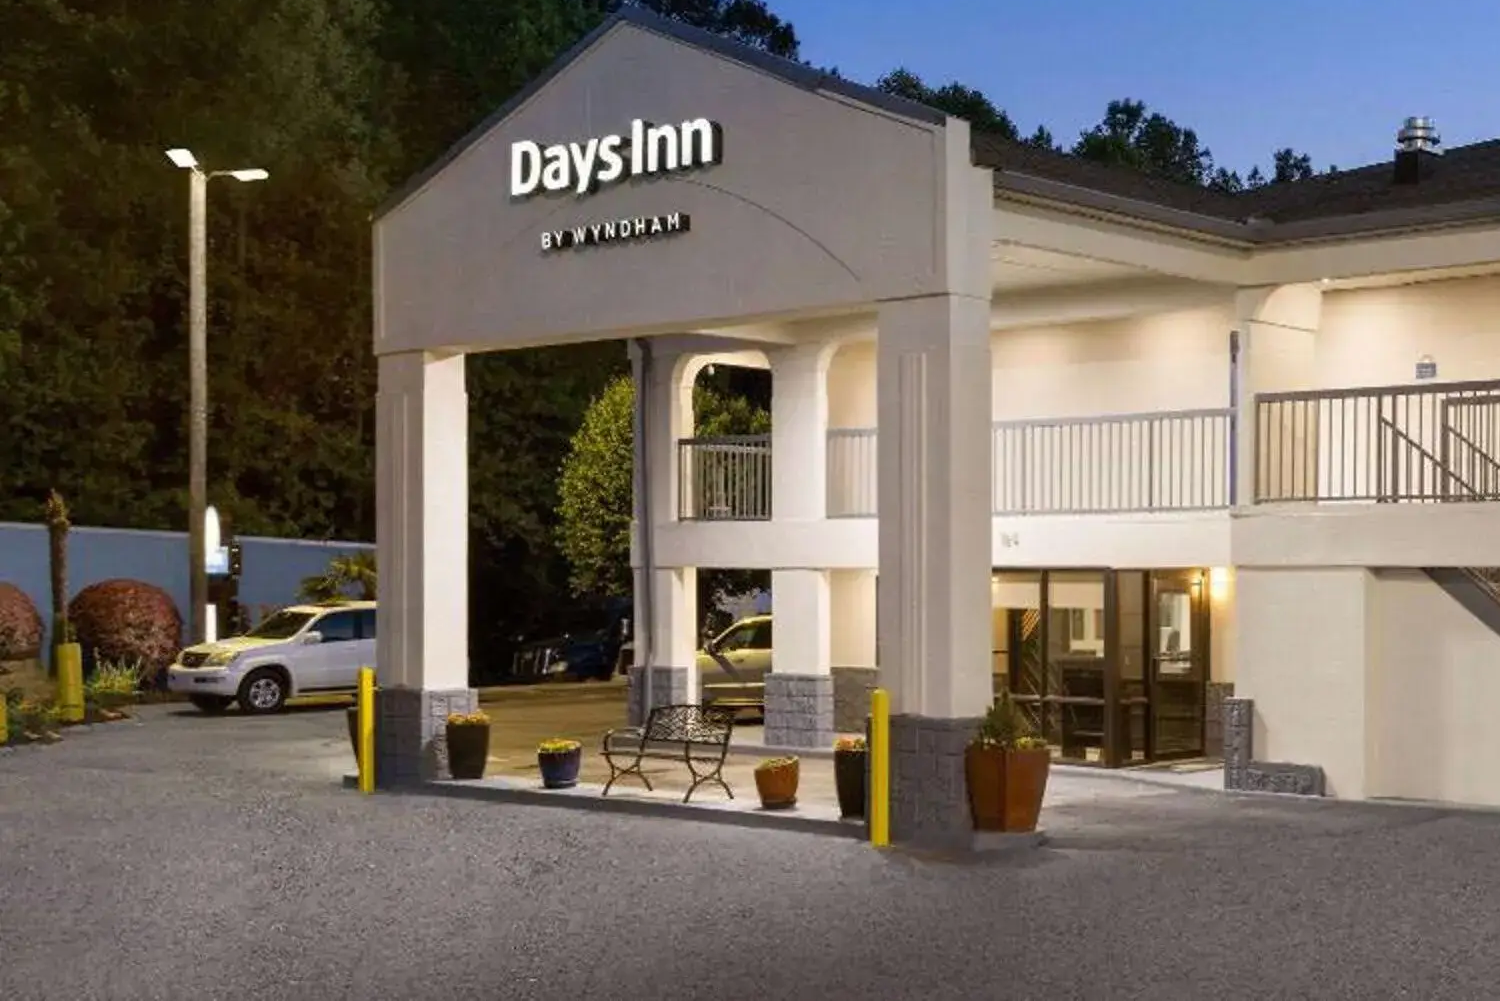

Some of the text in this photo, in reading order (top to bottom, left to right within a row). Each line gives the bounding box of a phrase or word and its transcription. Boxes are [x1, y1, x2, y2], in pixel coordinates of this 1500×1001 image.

[511, 117, 713, 196] Days Inn
[541, 212, 681, 250] BY WYNDHAM
